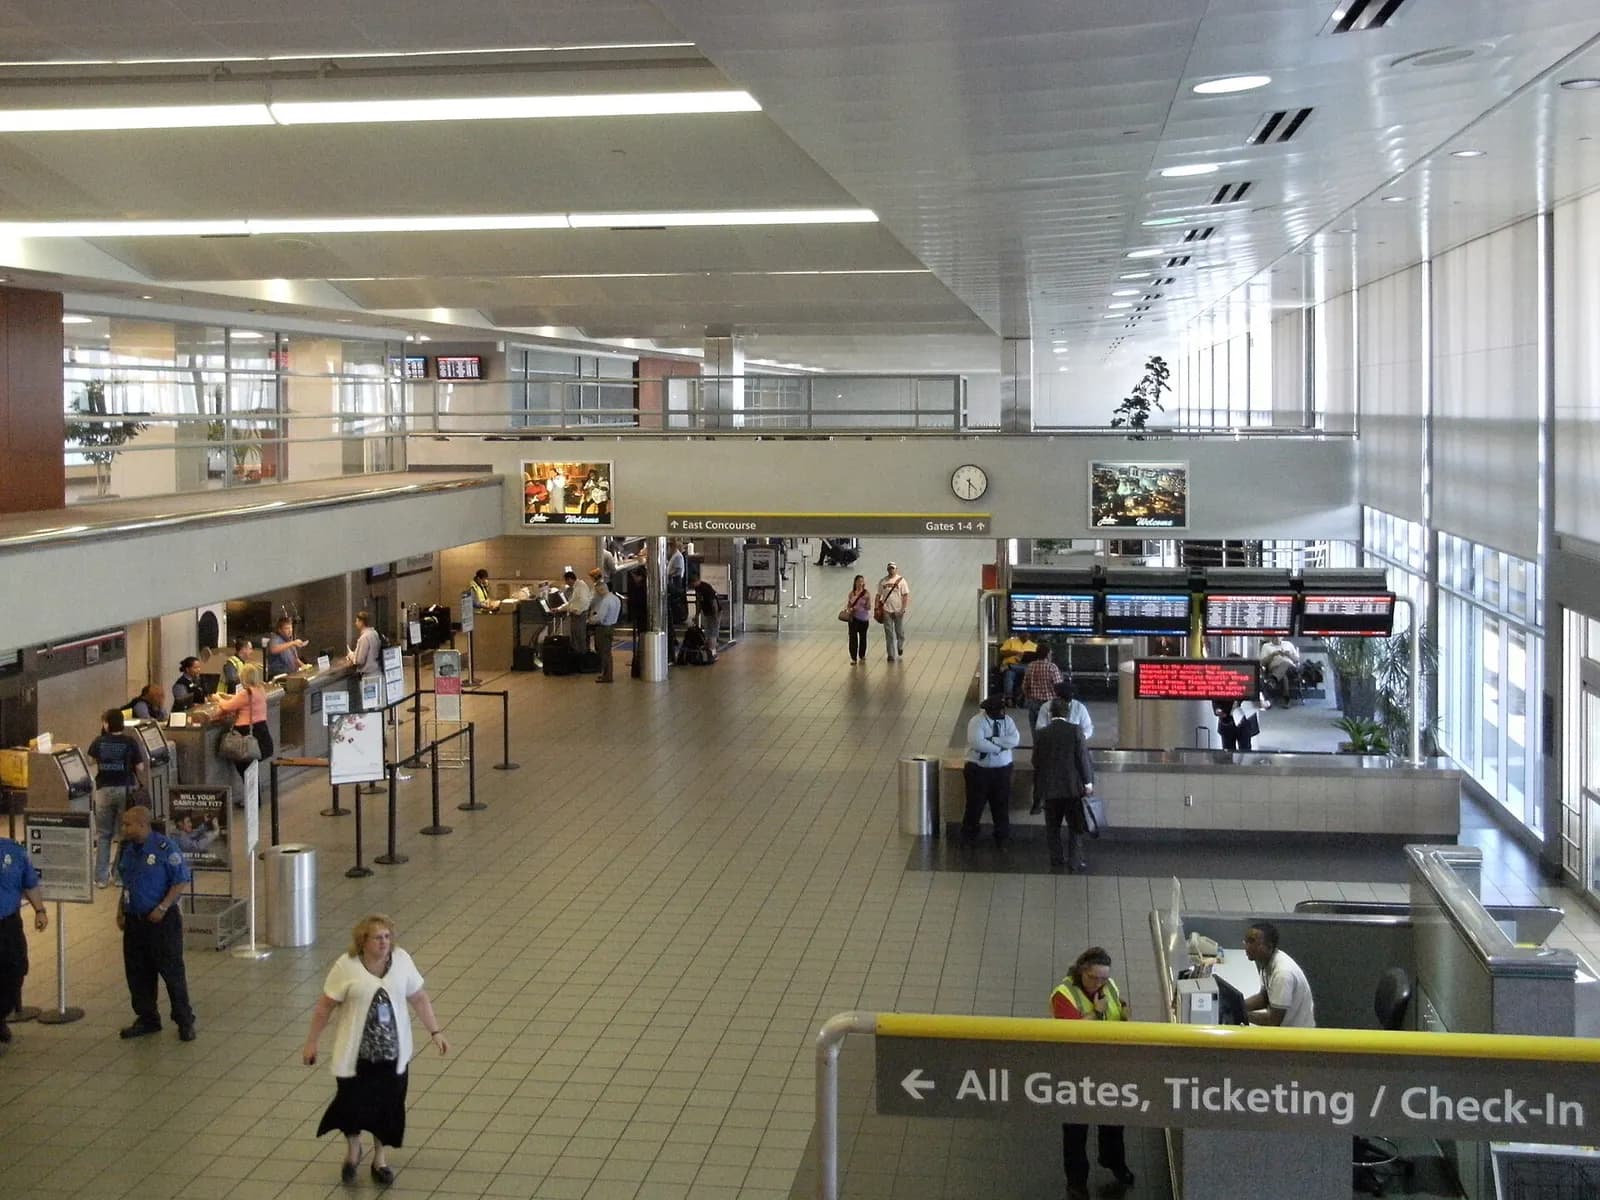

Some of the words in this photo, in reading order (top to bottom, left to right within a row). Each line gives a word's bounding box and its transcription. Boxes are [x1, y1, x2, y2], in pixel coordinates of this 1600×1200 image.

[682, 520, 703, 530] East
[705, 521, 757, 530] Concourse
[925, 521, 955, 531] Gates
[957, 521, 973, 531] 1-4
[956, 1069, 1009, 1101] All
[1024, 1072, 1150, 1112] Gates,
[1164, 1077, 1354, 1125] Ticketing
[1369, 1085, 1386, 1117] /
[1401, 1085, 1584, 1126] Check-In
